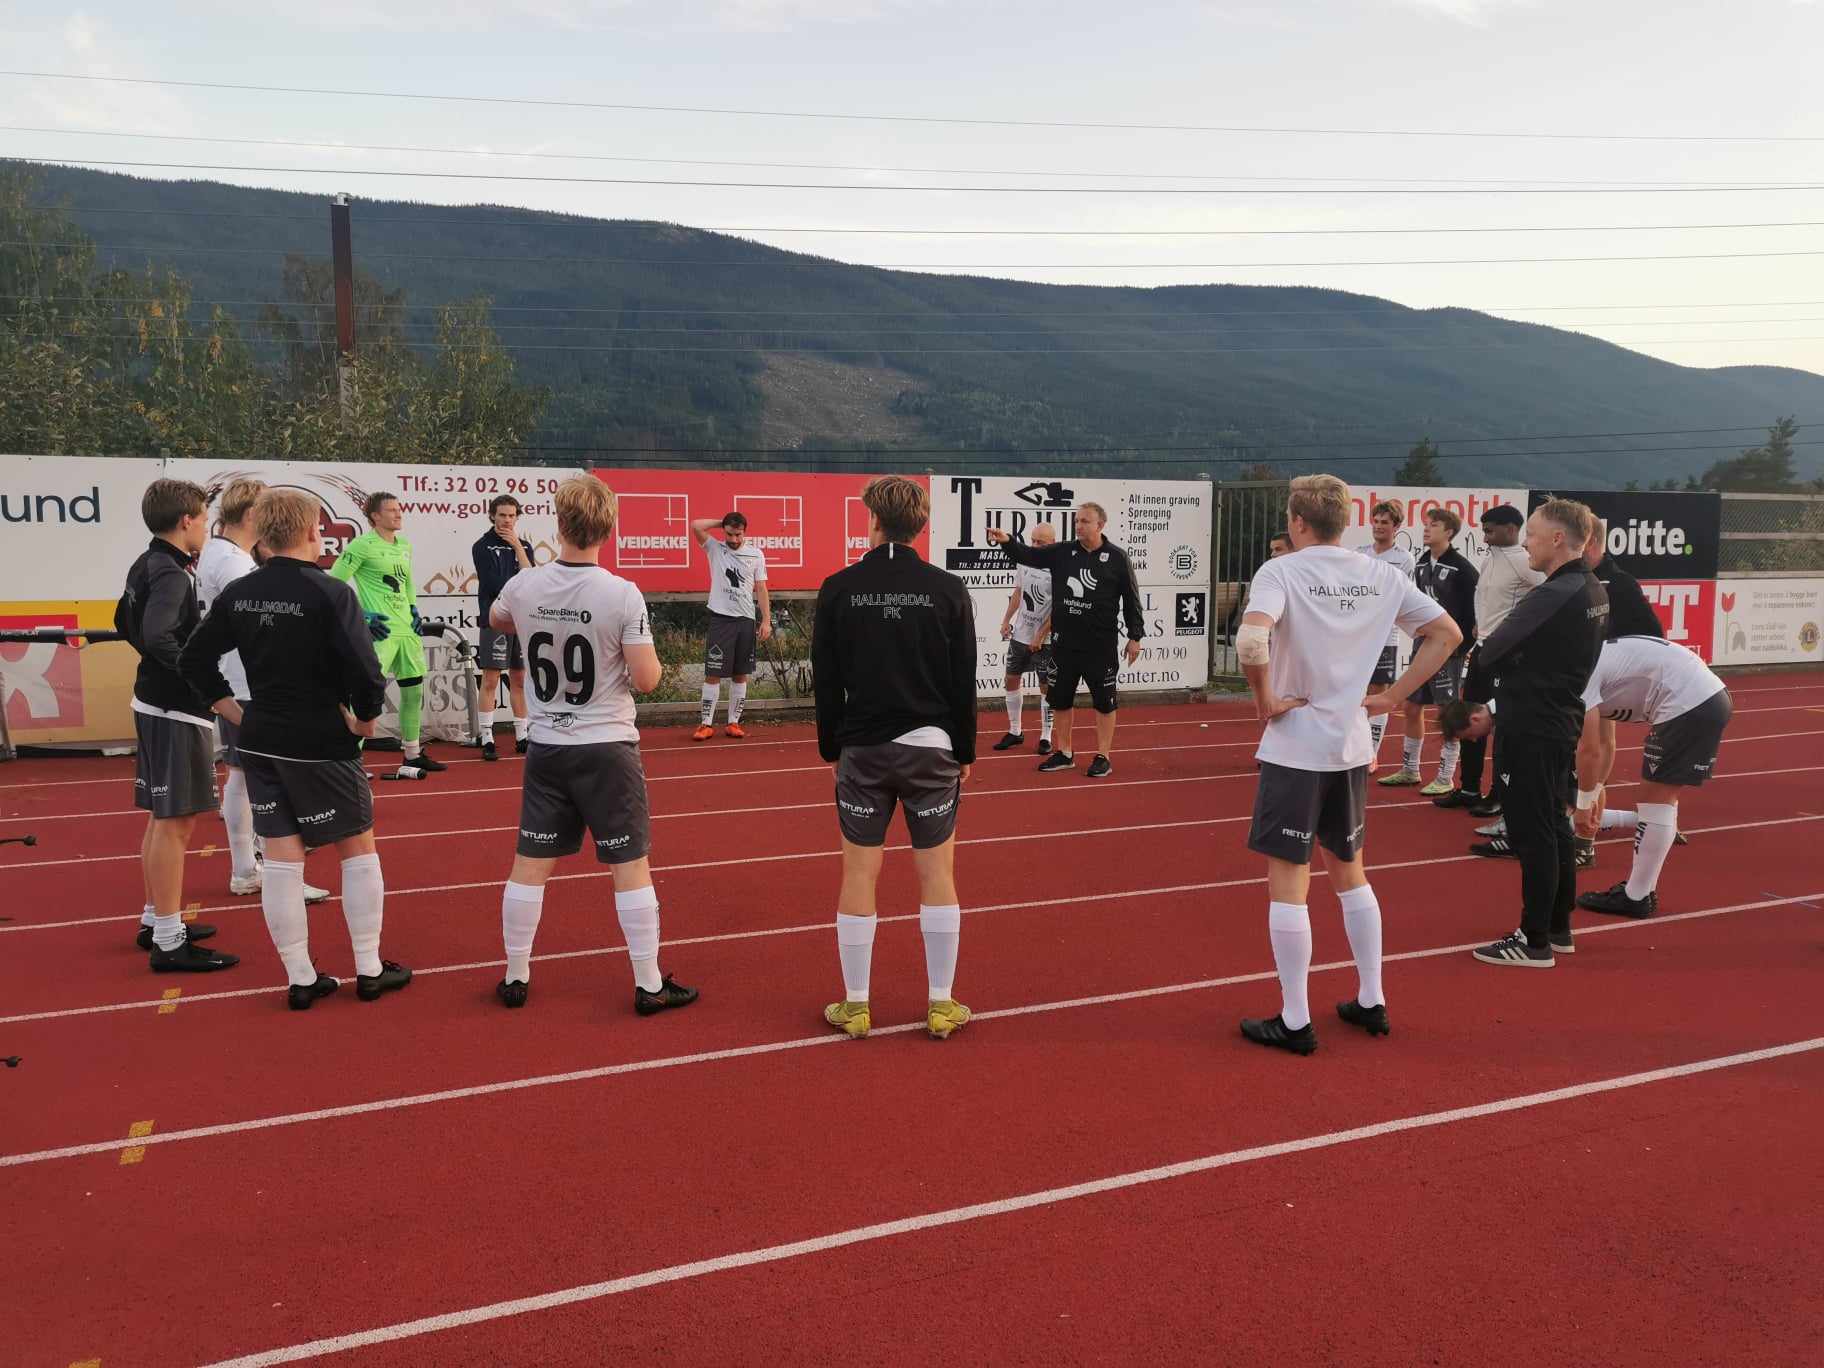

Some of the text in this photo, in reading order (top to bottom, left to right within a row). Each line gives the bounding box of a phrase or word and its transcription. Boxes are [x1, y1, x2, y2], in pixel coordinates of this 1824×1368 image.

[397, 475, 559, 495] Tlf.: 32 02 96 50
[1128, 494, 1200, 507] Alt innen graving
[1128, 507, 1172, 520] Sprenging
[1127, 520, 1169, 533] Transport
[617, 536, 688, 549] VEIDEKKE
[1127, 534, 1147, 544] Jord
[1127, 547, 1147, 557] Grus
[1130, 560, 1148, 570] ukk
[851, 592, 935, 607] HALLINGDAL
[1340, 599, 1356, 610] FK
[233, 599, 304, 617] HALLINGDAL
[537, 606, 580, 619] SpareBank
[883, 606, 902, 619] FK
[1176, 627, 1204, 636] PEUGEOT
[1157, 647, 1170, 661] 70
[1173, 646, 1187, 660] 90
[527, 631, 596, 706] 69
